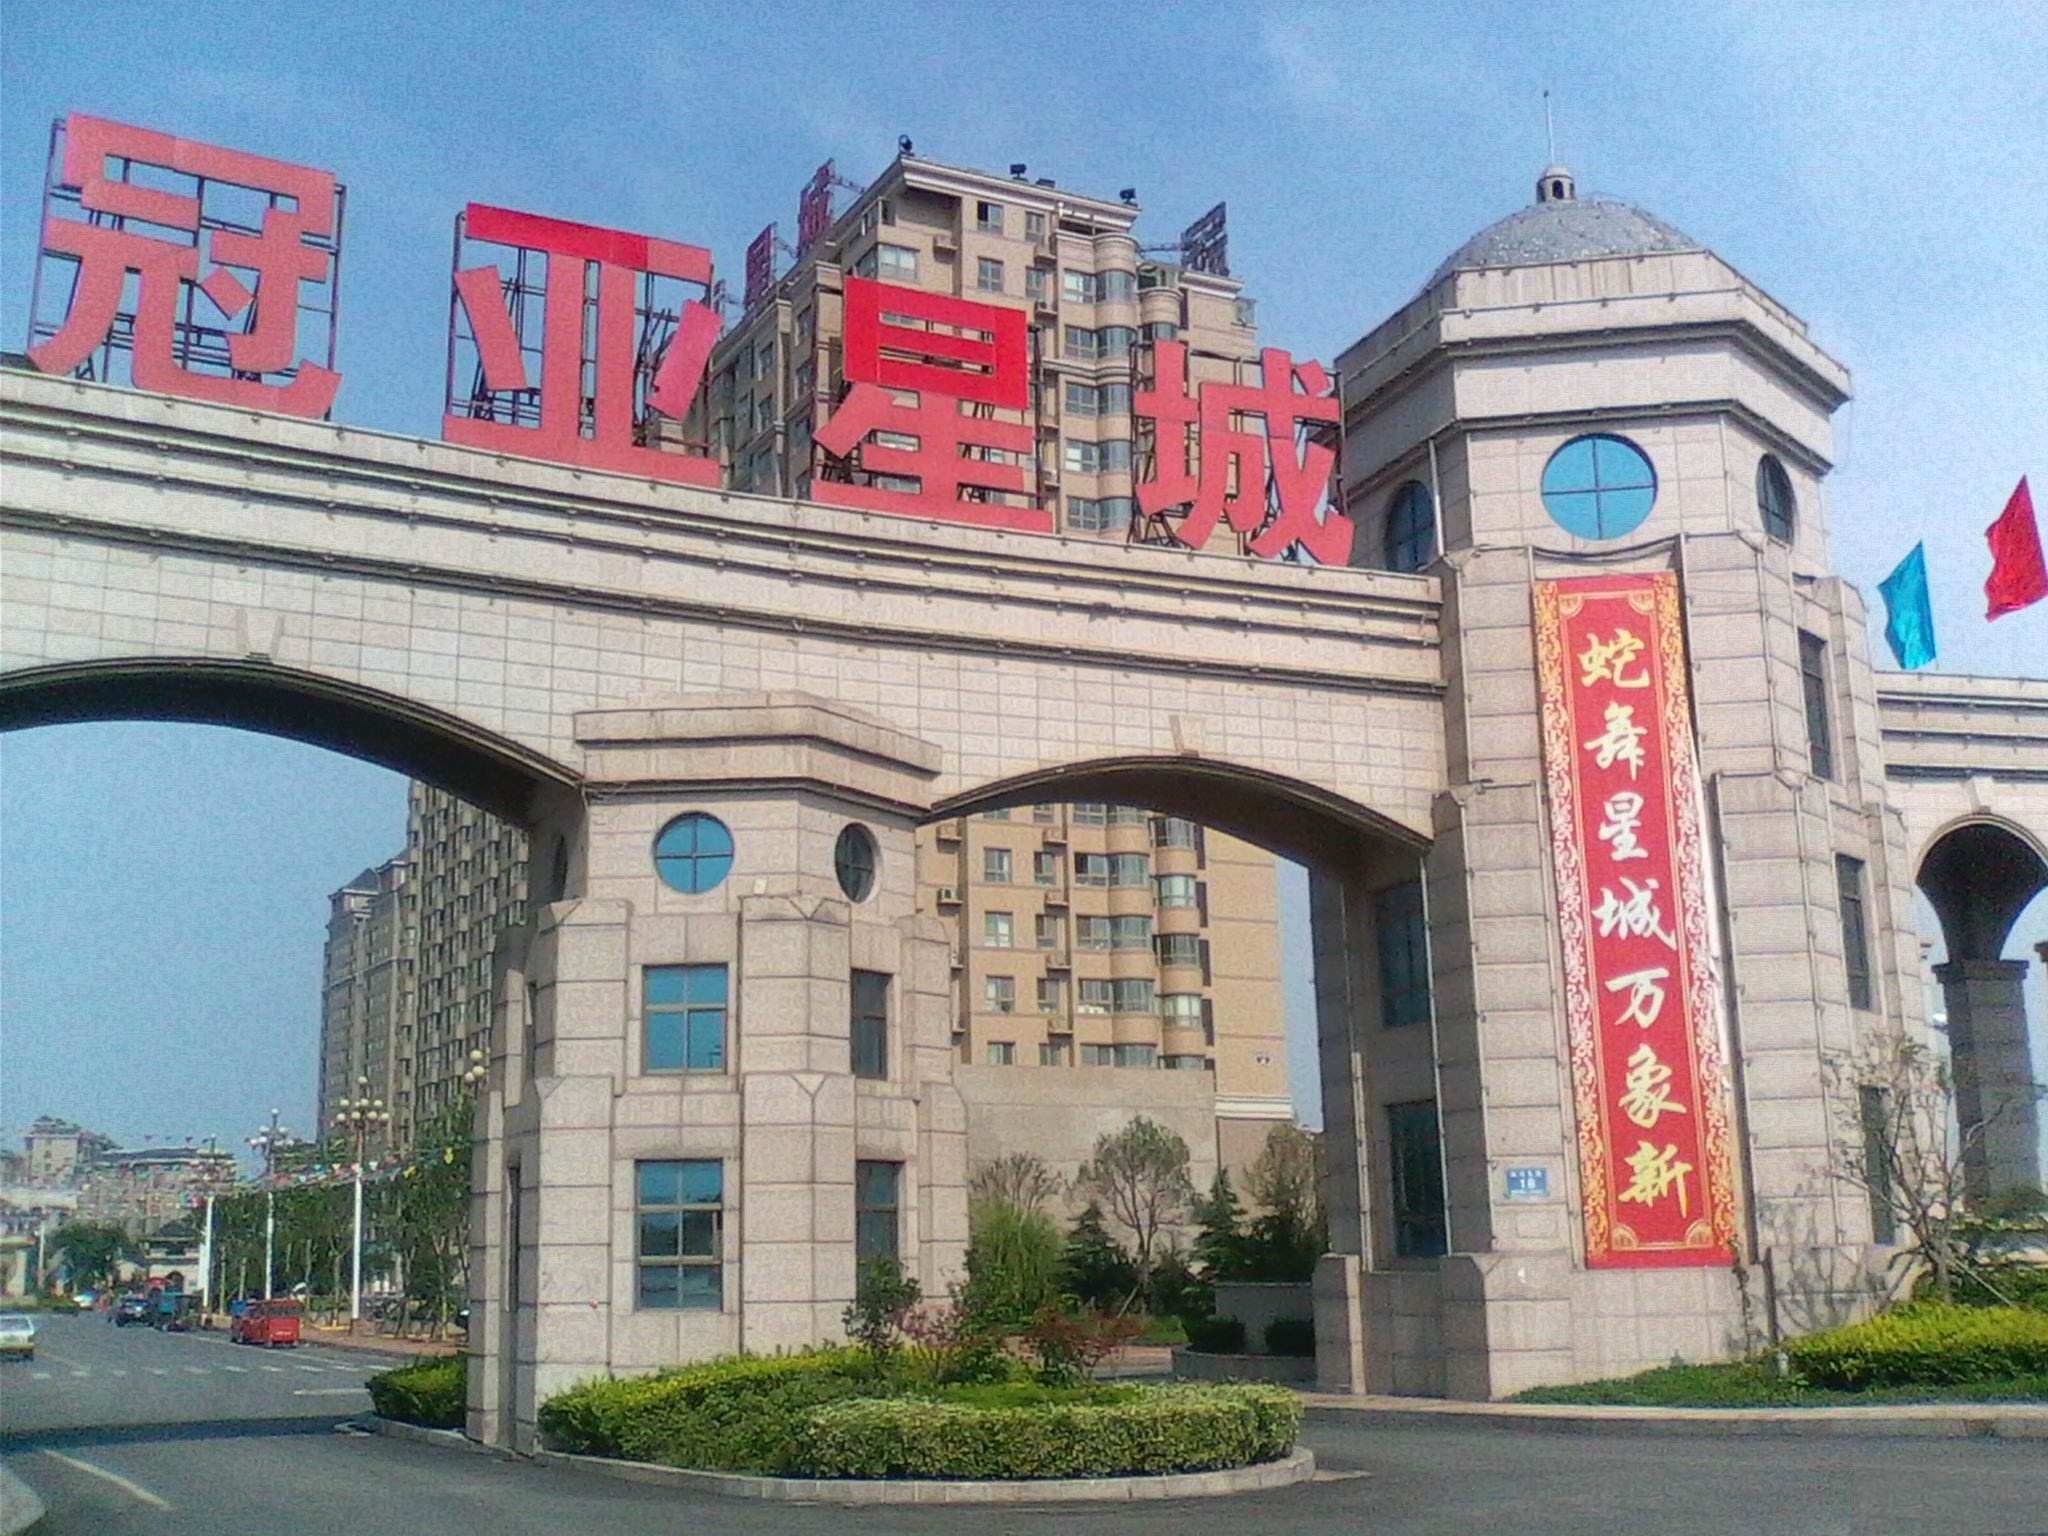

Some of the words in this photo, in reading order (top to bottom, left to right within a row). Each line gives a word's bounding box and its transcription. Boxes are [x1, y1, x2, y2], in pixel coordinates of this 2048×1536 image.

[27, 112, 1355, 566] 冠亚星城
[1577, 628, 1693, 1217] 蛇舞星城万象新
